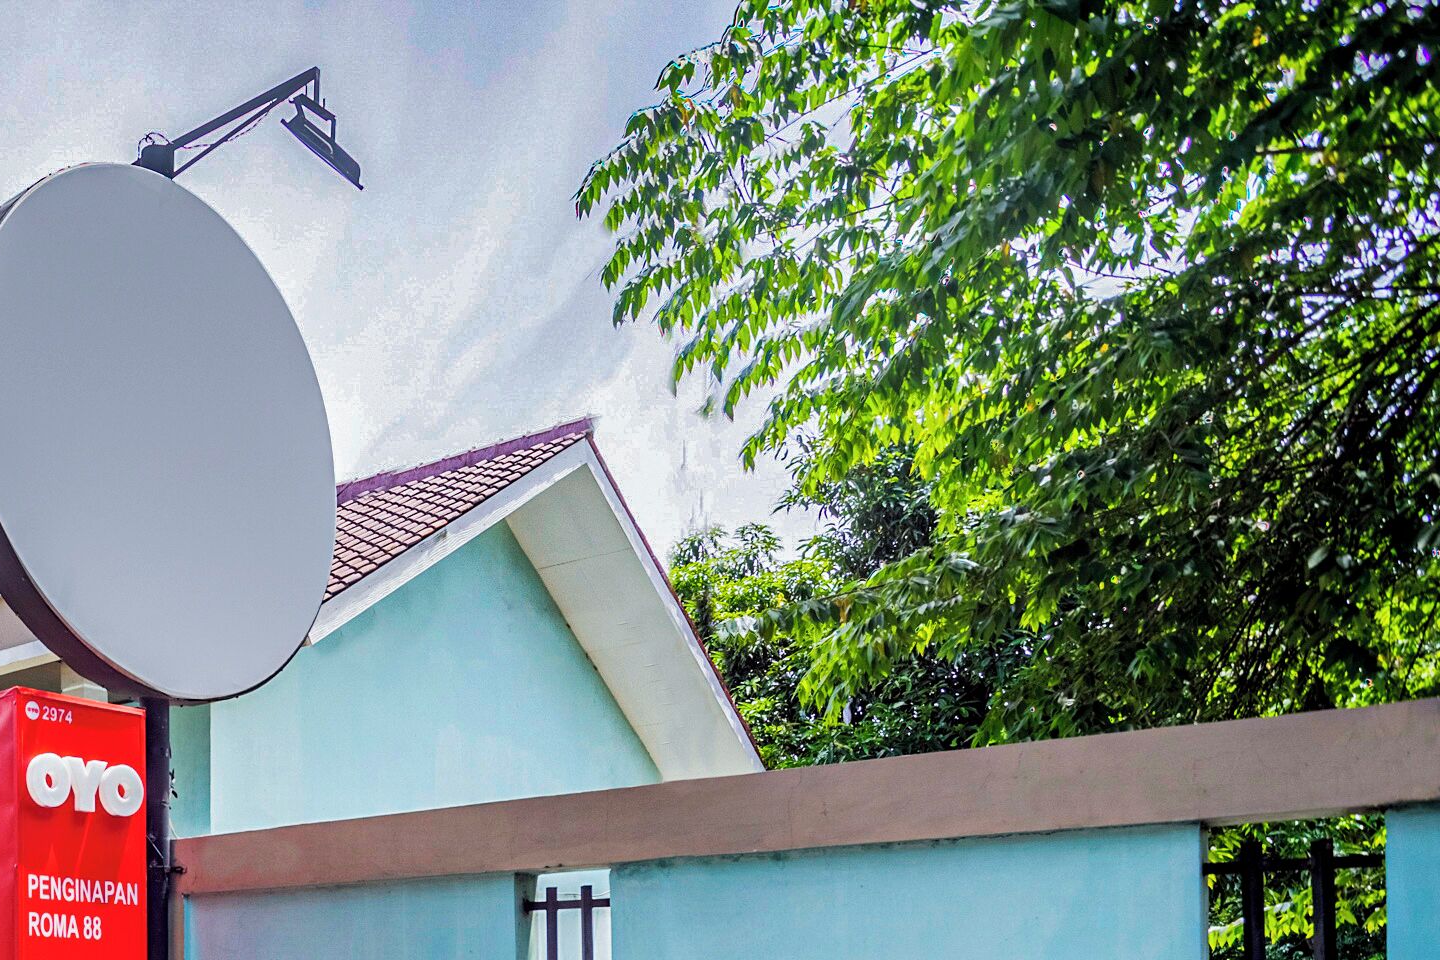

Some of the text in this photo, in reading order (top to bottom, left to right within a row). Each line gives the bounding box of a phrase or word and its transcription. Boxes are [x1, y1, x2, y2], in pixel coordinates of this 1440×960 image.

[42, 705, 73, 724] 2974
[26, 752, 144, 817] OYO
[27, 873, 138, 906] PENGINAPAN
[28, 911, 102, 940] ROMA 88
